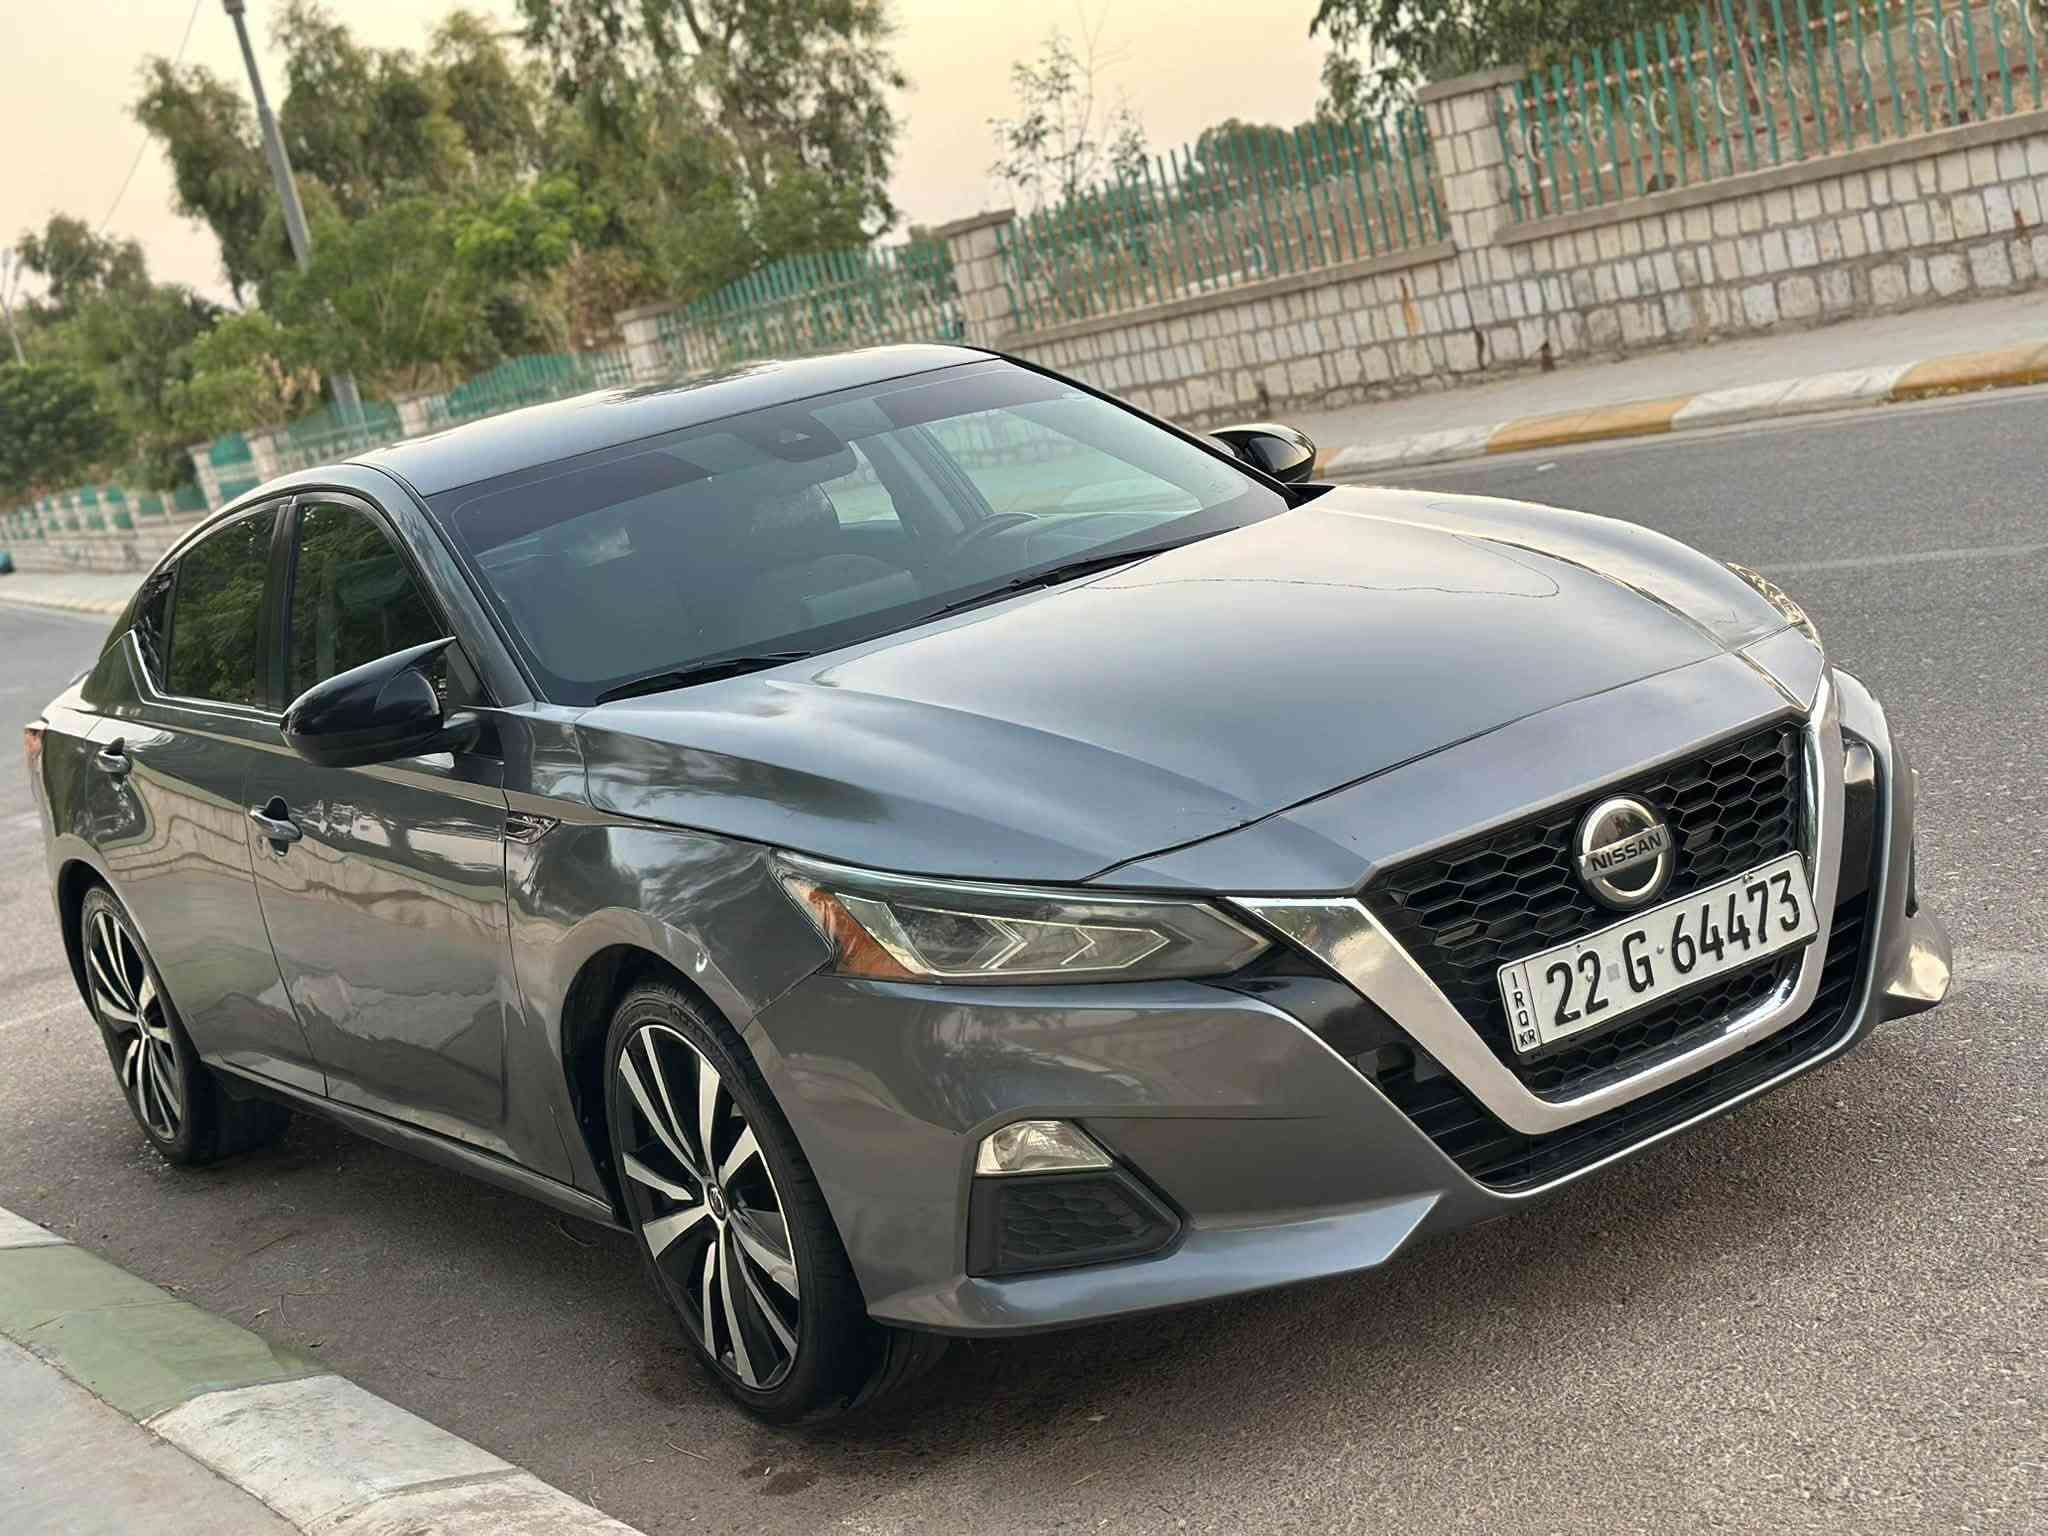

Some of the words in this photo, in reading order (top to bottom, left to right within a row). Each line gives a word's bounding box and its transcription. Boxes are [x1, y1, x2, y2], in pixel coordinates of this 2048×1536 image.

[1591, 832, 1662, 871] NISSAN
[1546, 950, 1608, 1027] 22
[1622, 930, 1654, 993] G
[1671, 870, 1801, 974] 64473
[1519, 1028, 1537, 1047] KR
